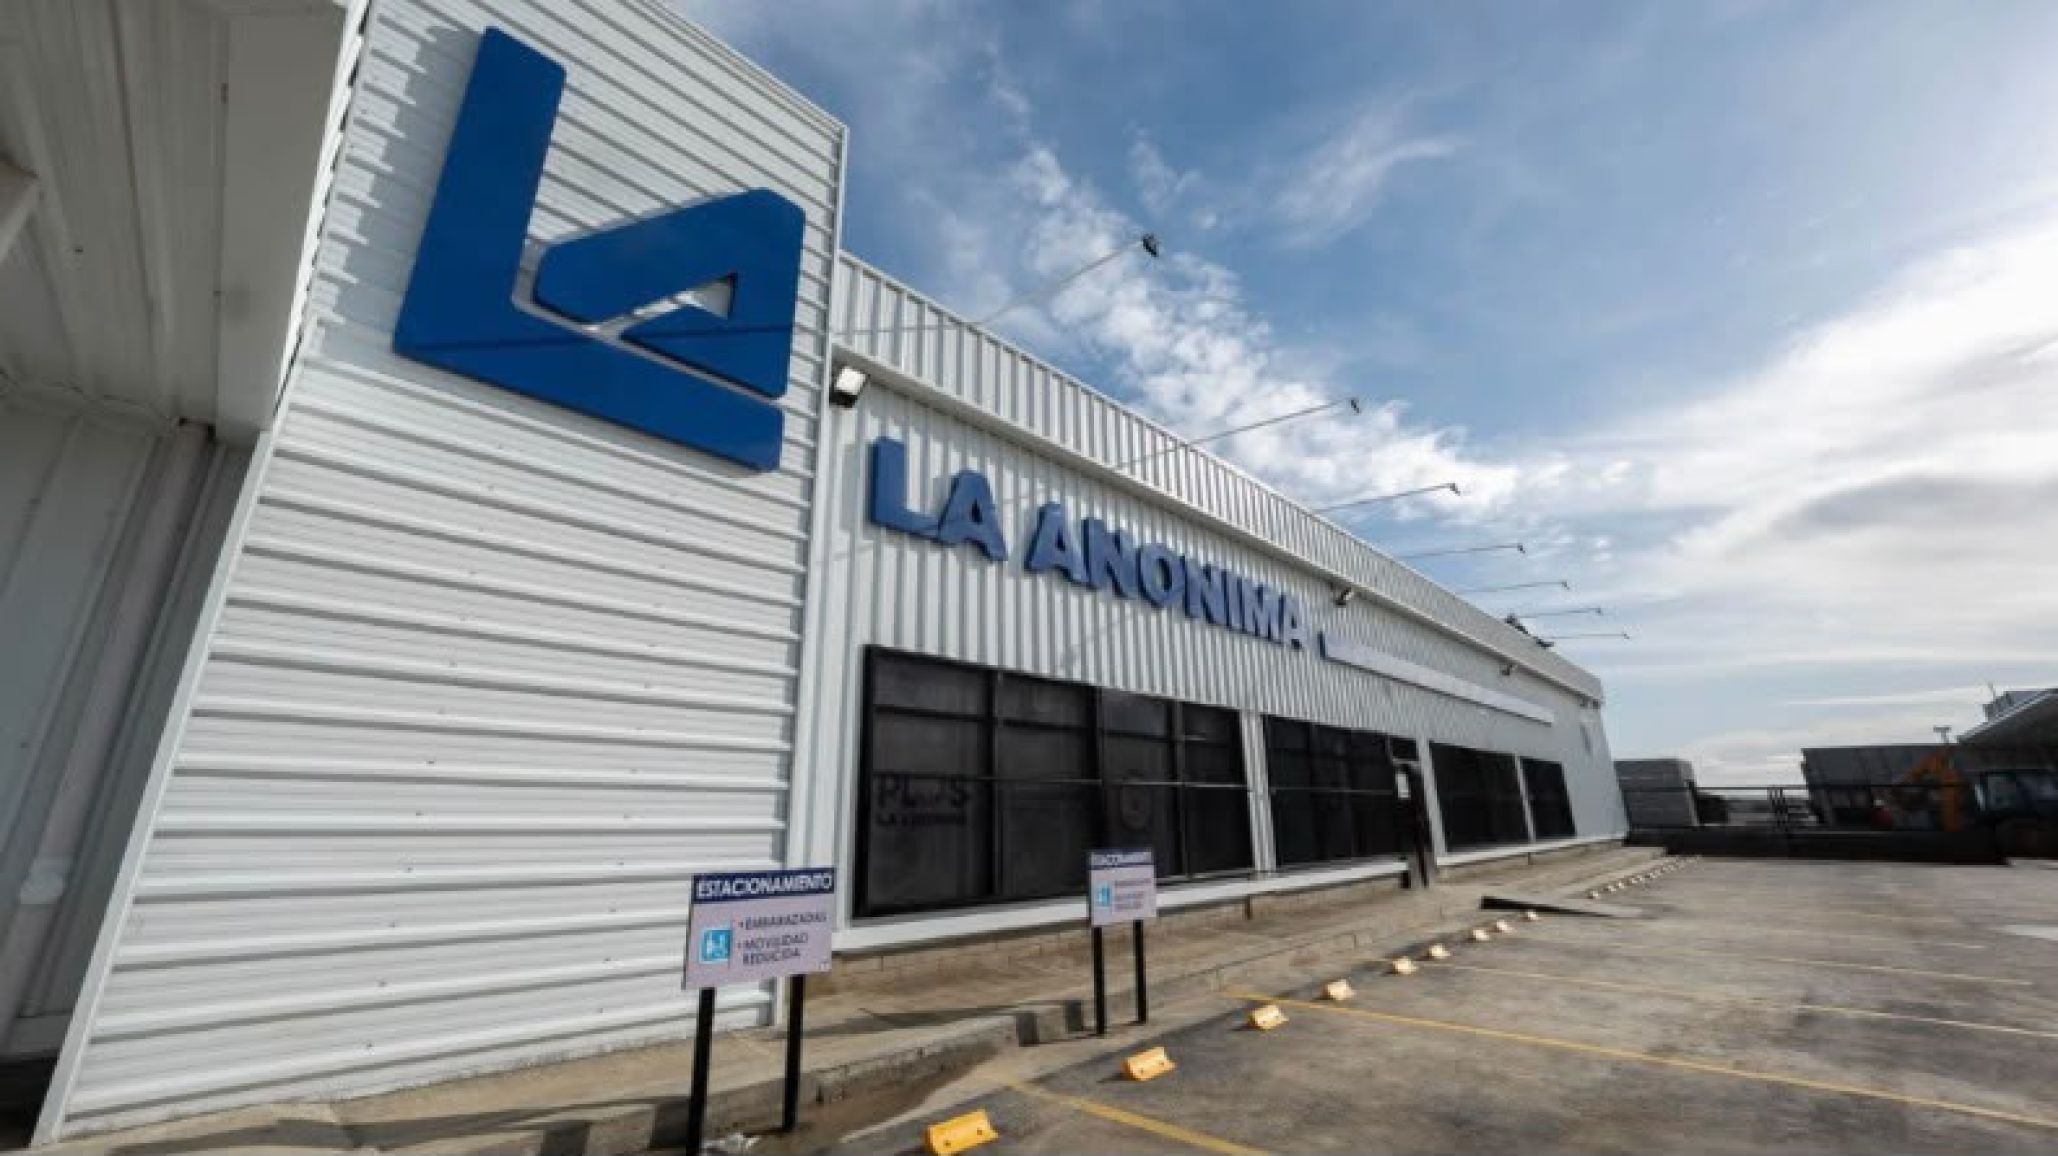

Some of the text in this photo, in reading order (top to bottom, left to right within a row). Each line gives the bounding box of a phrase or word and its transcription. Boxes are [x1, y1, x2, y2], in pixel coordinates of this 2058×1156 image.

[392, 26, 806, 473] LA
[870, 436, 1303, 650] LA ANONIMA
[696, 873, 832, 899] ESTACIONAMIENTO
